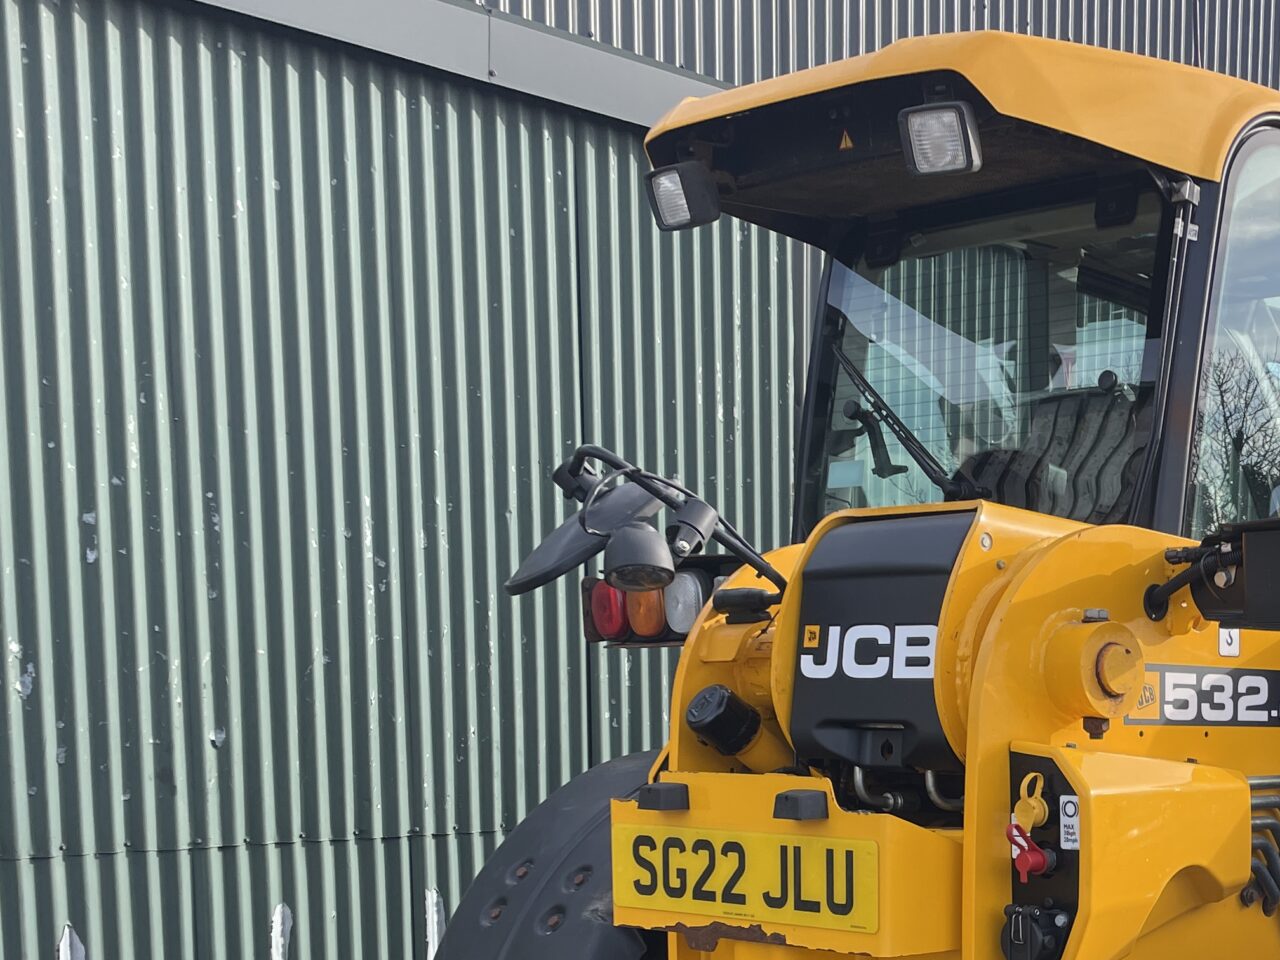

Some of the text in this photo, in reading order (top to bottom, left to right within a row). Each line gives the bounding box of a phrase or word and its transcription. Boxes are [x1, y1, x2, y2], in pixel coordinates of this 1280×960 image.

[801, 625, 938, 678] JCB
[632, 834, 854, 916] SG22 JLU
